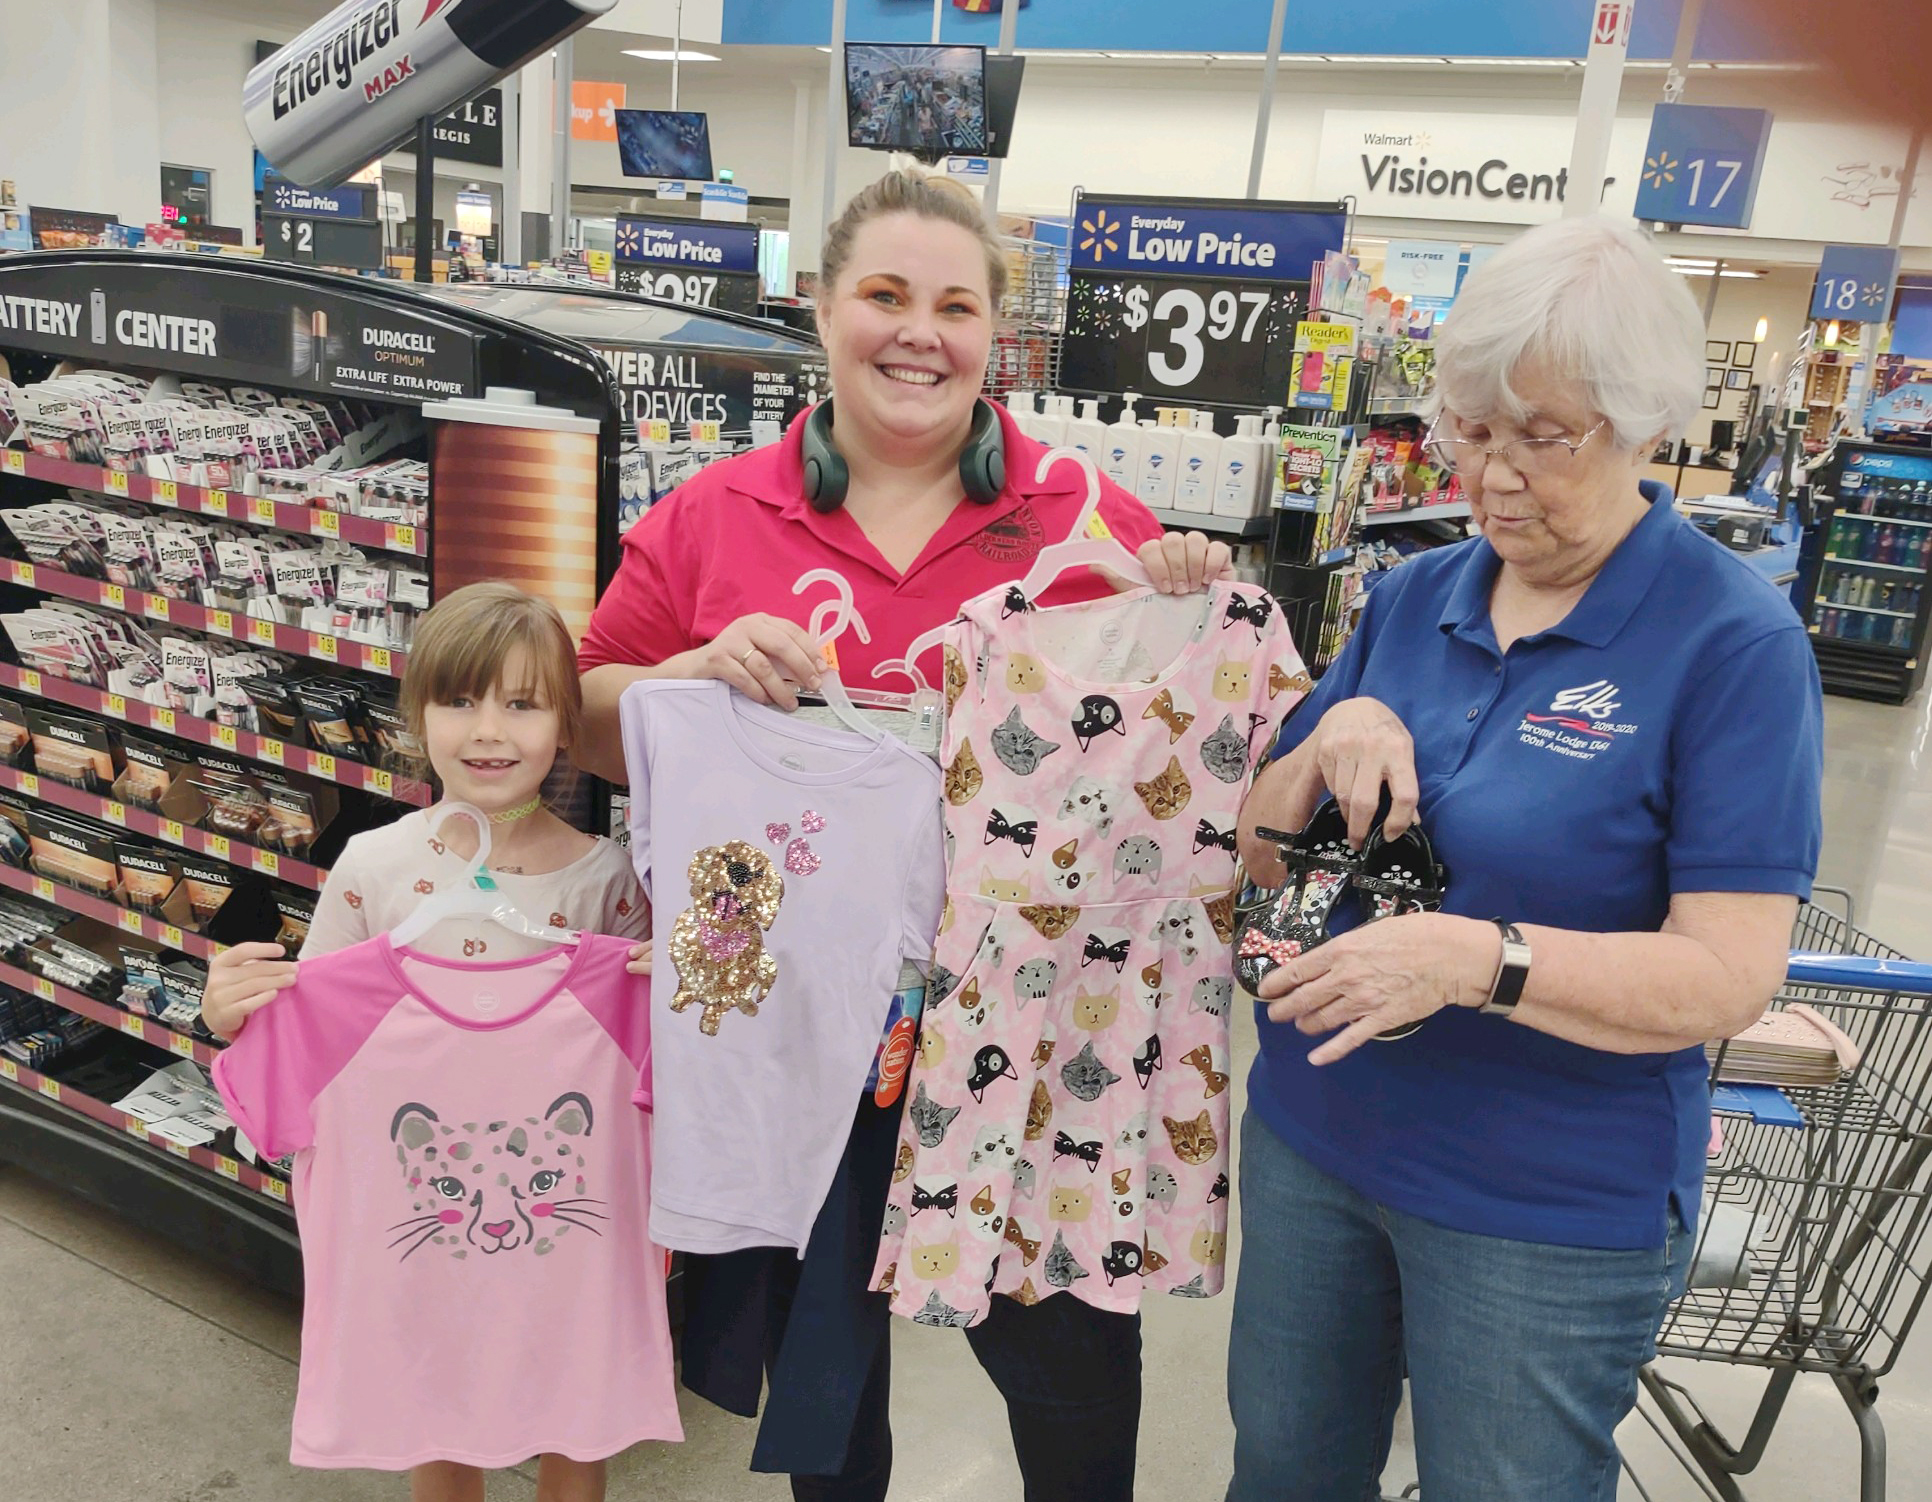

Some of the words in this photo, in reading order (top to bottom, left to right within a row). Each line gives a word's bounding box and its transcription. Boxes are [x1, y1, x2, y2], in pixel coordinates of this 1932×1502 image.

[272, 0, 401, 121] Energizer
[363, 55, 415, 102] MAX
[1363, 132, 1413, 147] Walmart
[1361, 154, 1616, 204] VisionCentr
[1686, 159, 1742, 209] 17
[292, 196, 314, 209] Low
[314, 198, 338, 212] Price
[1131, 215, 1185, 232] Everyday
[643, 228, 674, 240] Everyday
[643, 236, 678, 259] Low
[680, 240, 722, 263] Price
[1128, 229, 1193, 263] Low
[1196, 232, 1276, 267] Price
[1401, 252, 1444, 261] RISK-FREE
[1823, 279, 1858, 310] 18
[115, 309, 217, 357] CENTER
[363, 327, 436, 353] DURACELL
[375, 351, 425, 367] OPTIMUM
[336, 366, 367, 380] EXTRA
[368, 370, 389, 384] LIFE
[393, 374, 425, 389] EXTRA
[426, 379, 463, 395] POWER
[660, 354, 703, 389] ALL
[753, 371, 771, 382] FIND
[771, 372, 786, 383] THE
[753, 384, 794, 396] DIAMETER
[633, 389, 727, 425] DEVICES
[753, 398, 763, 407] OF
[764, 398, 784, 408] YOUR
[753, 410, 784, 421] BATTERY
[108, 419, 141, 435] Energizer
[204, 423, 250, 440] Energizer
[1283, 425, 1337, 443] Prevention
[1863, 457, 1893, 470] pepsi
[108, 528, 142, 547] Energizer
[161, 546, 196, 563] Energizer
[276, 566, 315, 585] Energizer
[165, 651, 206, 669] Energizer
[1550, 680, 1621, 718] Elks
[49, 725, 86, 743] DURACELL
[1517, 720, 1555, 738] Jerome
[1555, 731, 1589, 749] Lodge
[1520, 733, 1545, 747] 100th
[1545, 742, 1596, 760] Anniversary
[125, 747, 164, 767] DURACELL
[197, 755, 244, 774] DURACELL
[270, 796, 303, 813] DURACELL
[49, 830, 88, 852] DURACELL
[119, 854, 167, 873] DURACELL
[183, 867, 231, 885] DURACELL
